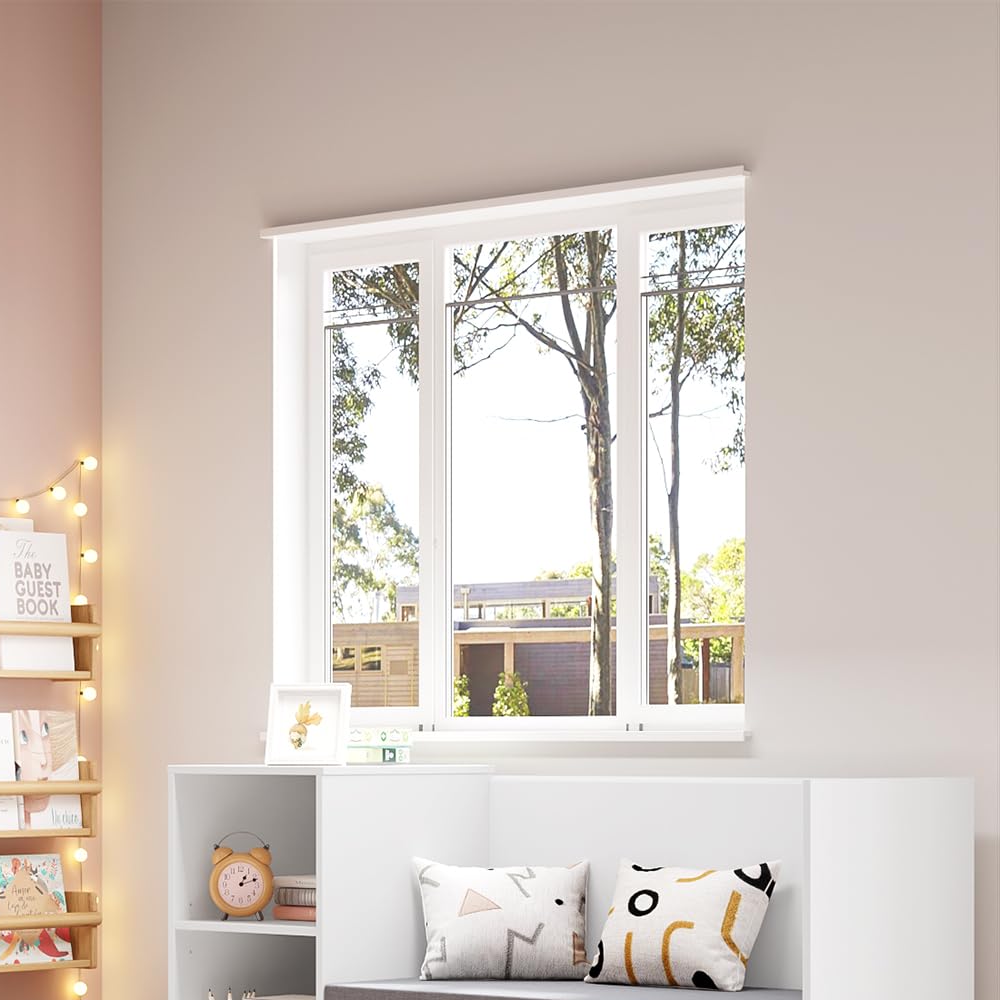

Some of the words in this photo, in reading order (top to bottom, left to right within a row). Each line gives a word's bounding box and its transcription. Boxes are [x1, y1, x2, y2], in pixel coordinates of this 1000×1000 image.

[12, 538, 38, 559] The
[14, 561, 51, 580] BABY
[15, 580, 61, 598] GUEST
[17, 598, 59, 616] BOOK
